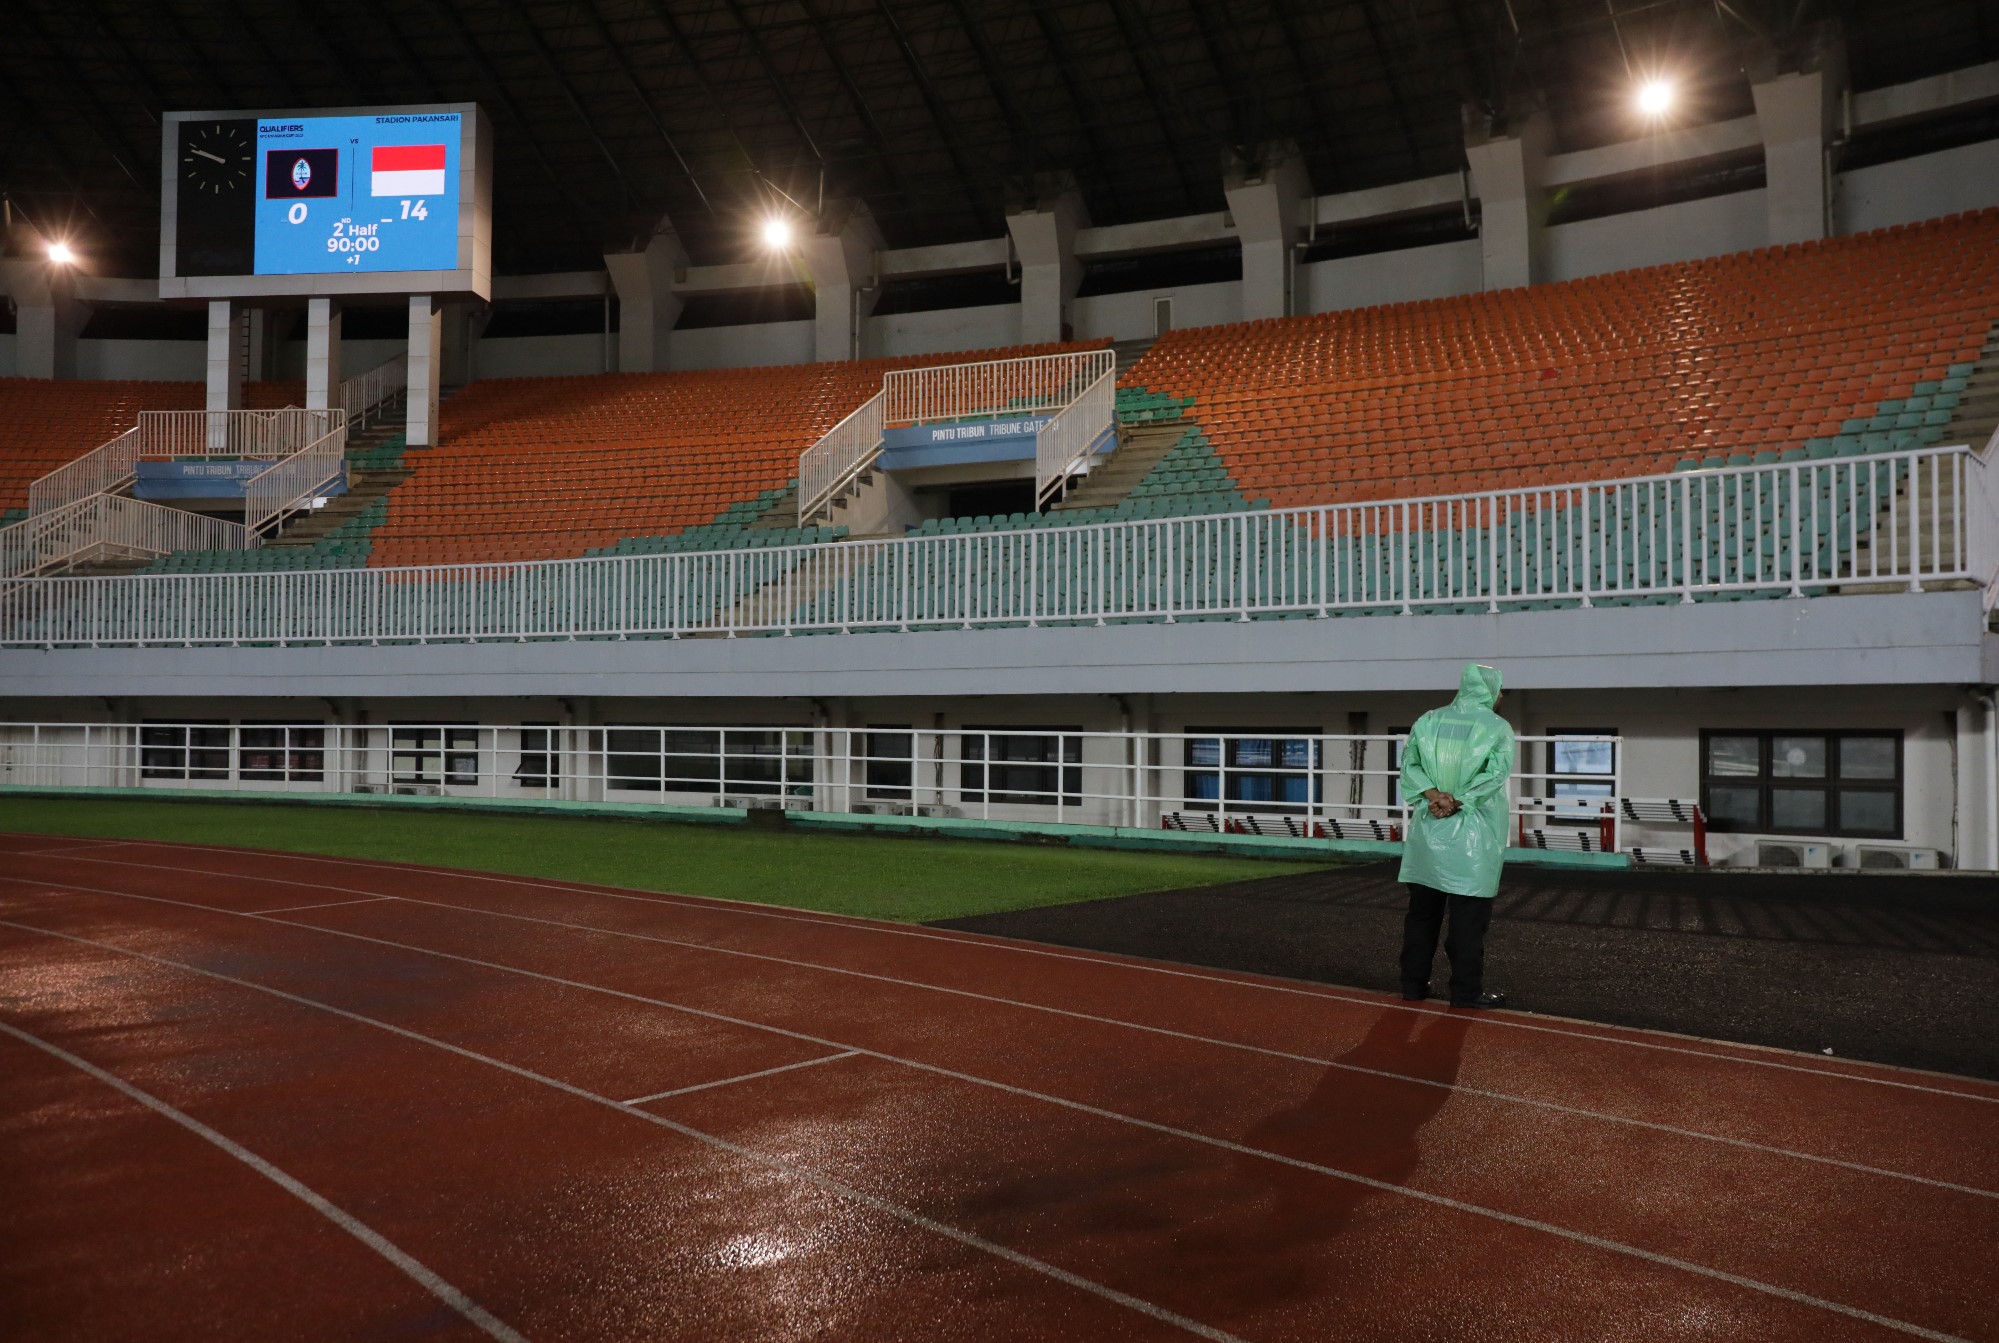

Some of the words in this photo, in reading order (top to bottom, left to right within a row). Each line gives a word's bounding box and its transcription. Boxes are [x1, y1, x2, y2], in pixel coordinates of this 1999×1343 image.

[375, 116, 411, 124] STADION
[412, 115, 459, 123] PAKANSARI
[259, 125, 304, 133] QUALIFIERS
[288, 202, 308, 225] 0
[400, 200, 428, 221] 14
[348, 223, 378, 237] Half
[327, 236, 380, 253] 90:00
[346, 254, 360, 266] +1
[932, 428, 955, 441] PINTU
[956, 425, 985, 439] TRIBUN
[990, 422, 1022, 436] TRIBUNE
[1023, 420, 1045, 433] GATE
[183, 465, 205, 475] PINTU
[205, 465, 232, 475] TRIBUN
